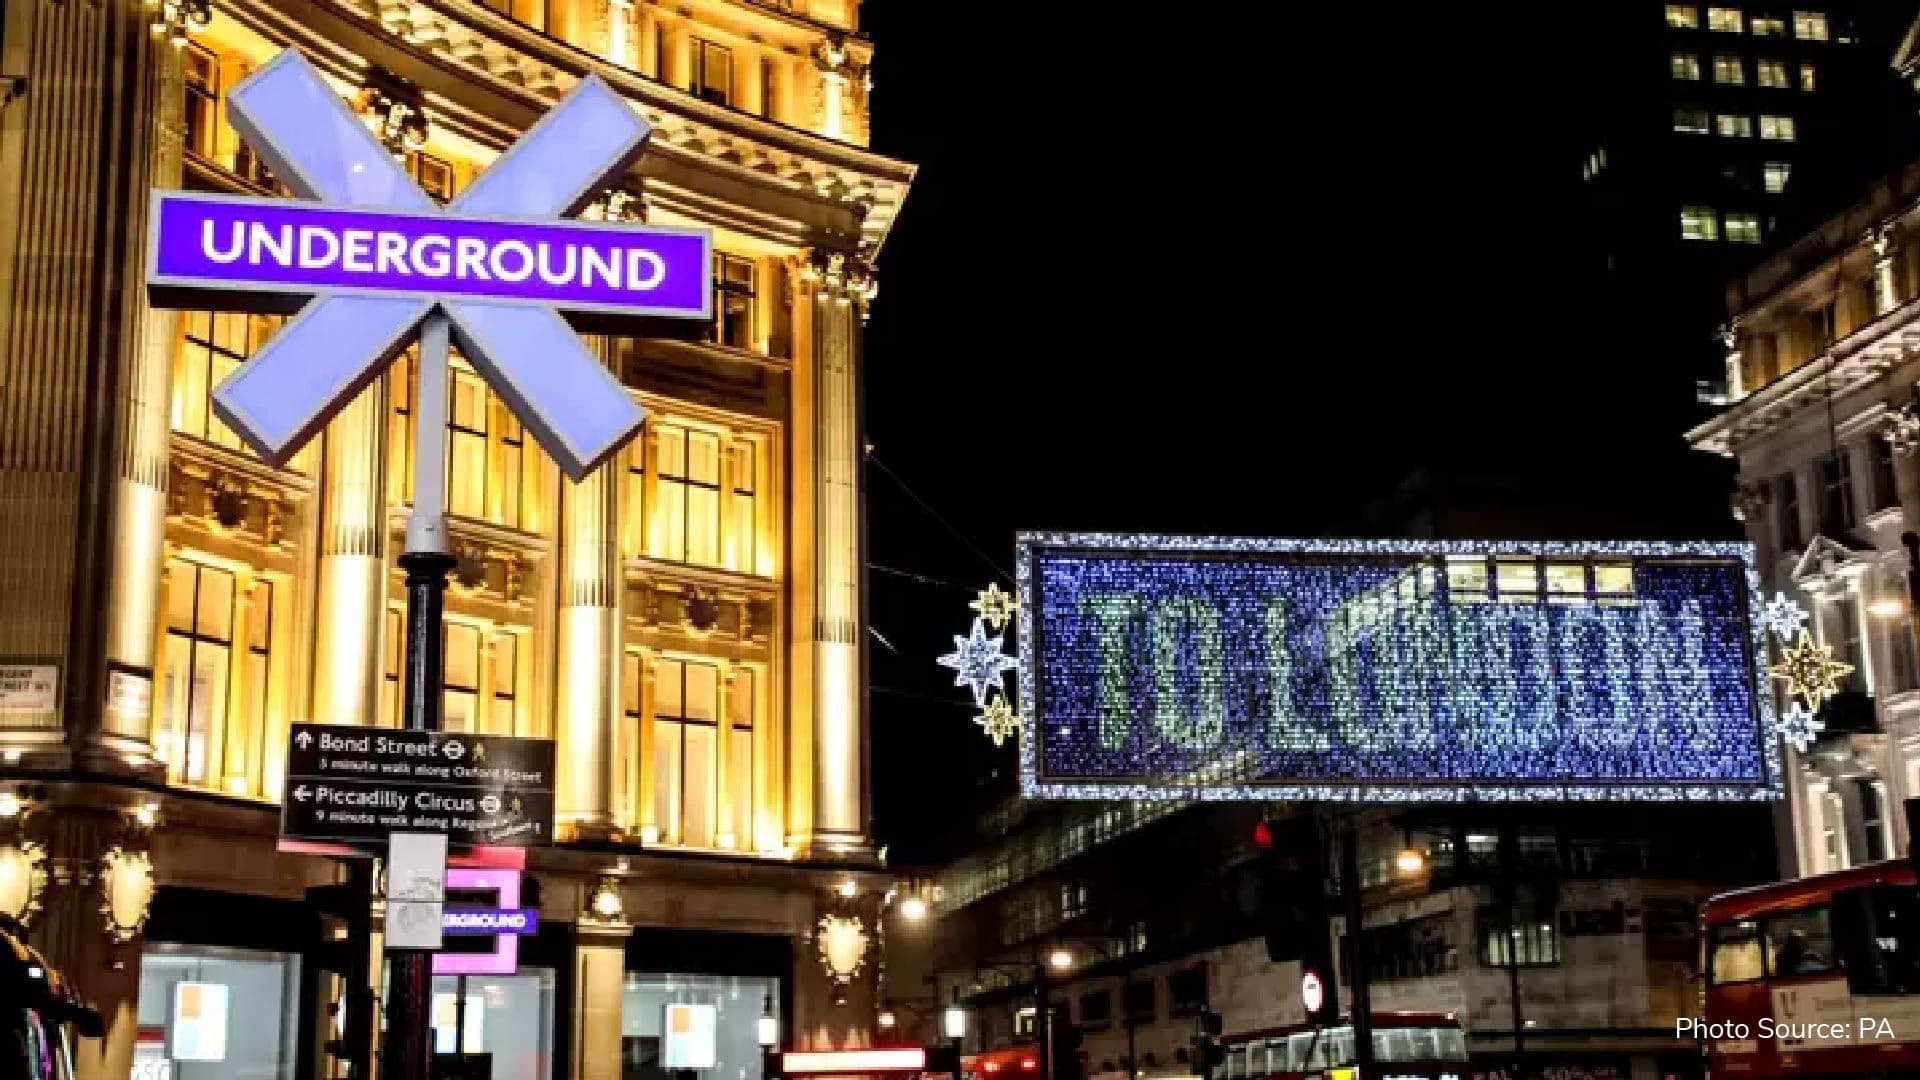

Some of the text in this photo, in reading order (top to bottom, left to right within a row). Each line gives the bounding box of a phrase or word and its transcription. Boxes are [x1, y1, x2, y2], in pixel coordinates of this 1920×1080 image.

[202, 218, 666, 291] UNDERGROUND
[1080, 594, 1714, 753] TO LONDON
[319, 732, 438, 757] Bond Street
[331, 758, 378, 772] minute
[381, 760, 411, 775] walk
[414, 763, 450, 781] along
[453, 765, 500, 779] Oxford
[503, 768, 542, 785] Street
[316, 785, 475, 812] Piccadilly Circus
[329, 811, 376, 825] minute
[379, 814, 408, 828] walk
[412, 815, 449, 831] along
